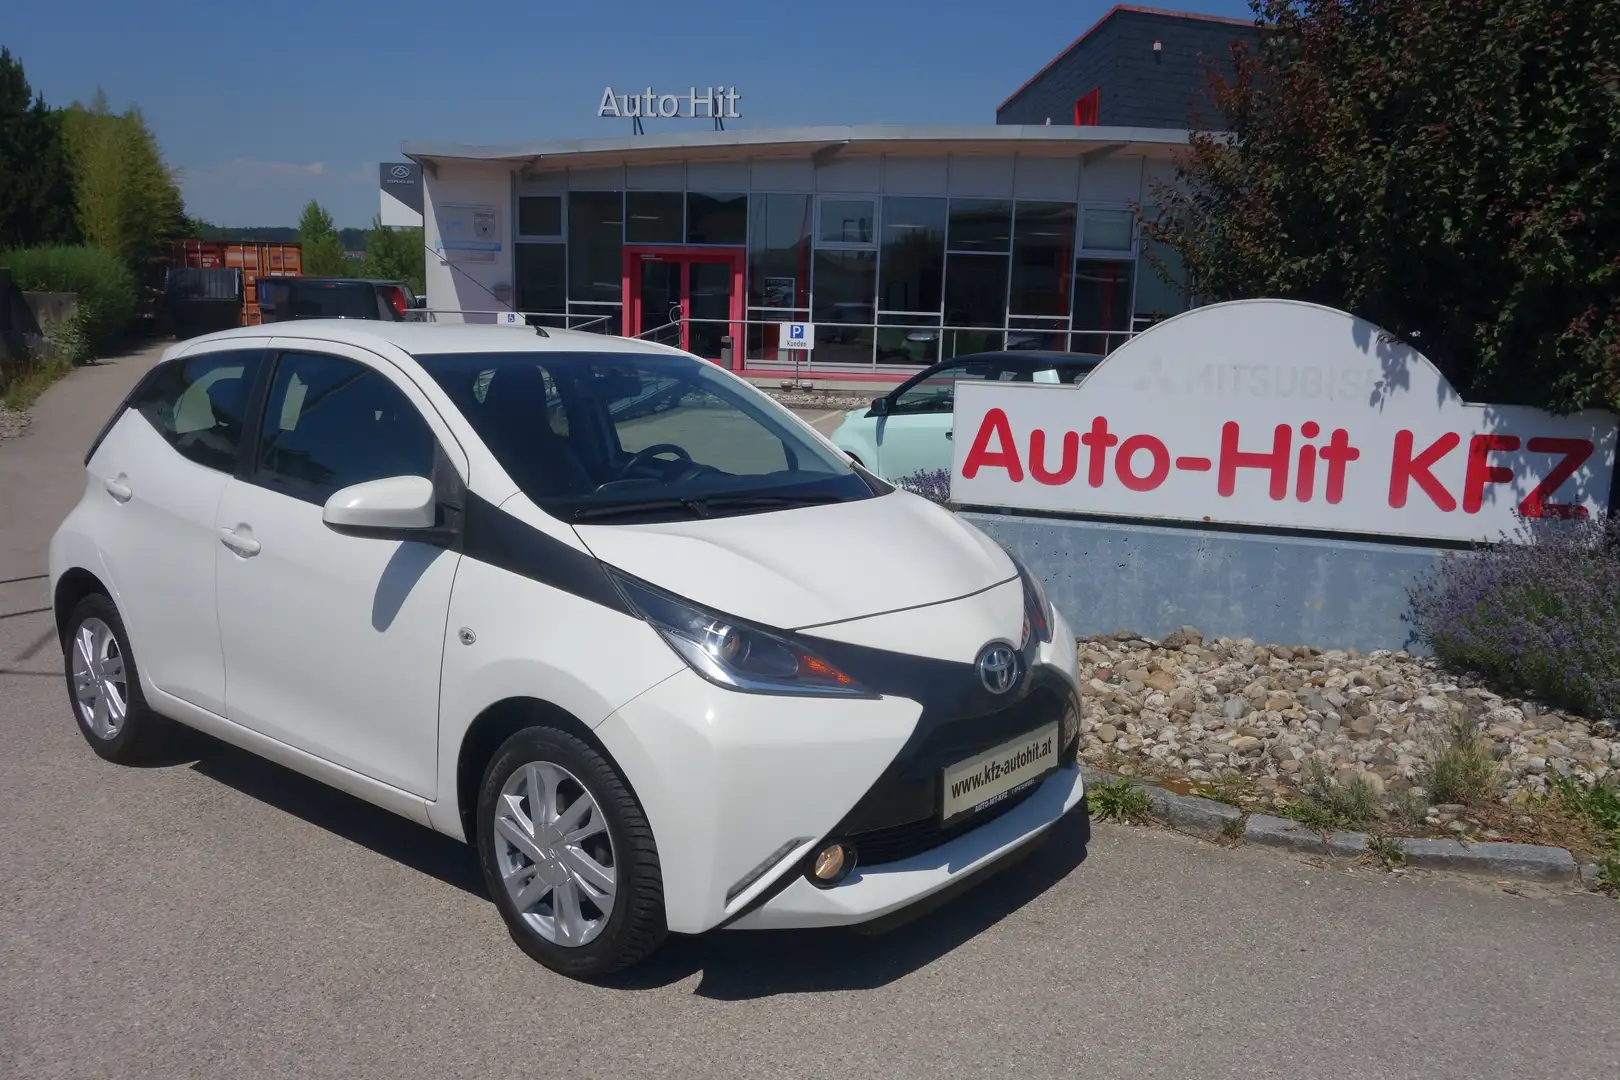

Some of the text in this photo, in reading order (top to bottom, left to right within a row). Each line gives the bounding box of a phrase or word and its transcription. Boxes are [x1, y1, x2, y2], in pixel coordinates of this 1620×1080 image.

[597, 85, 742, 118] Auto Hit
[786, 340, 807, 348] Kunden
[792, 325, 802, 338] P
[961, 407, 1595, 520] Auto-Hit KFZ
[951, 736, 1052, 799] www.kfz-autohit.at
